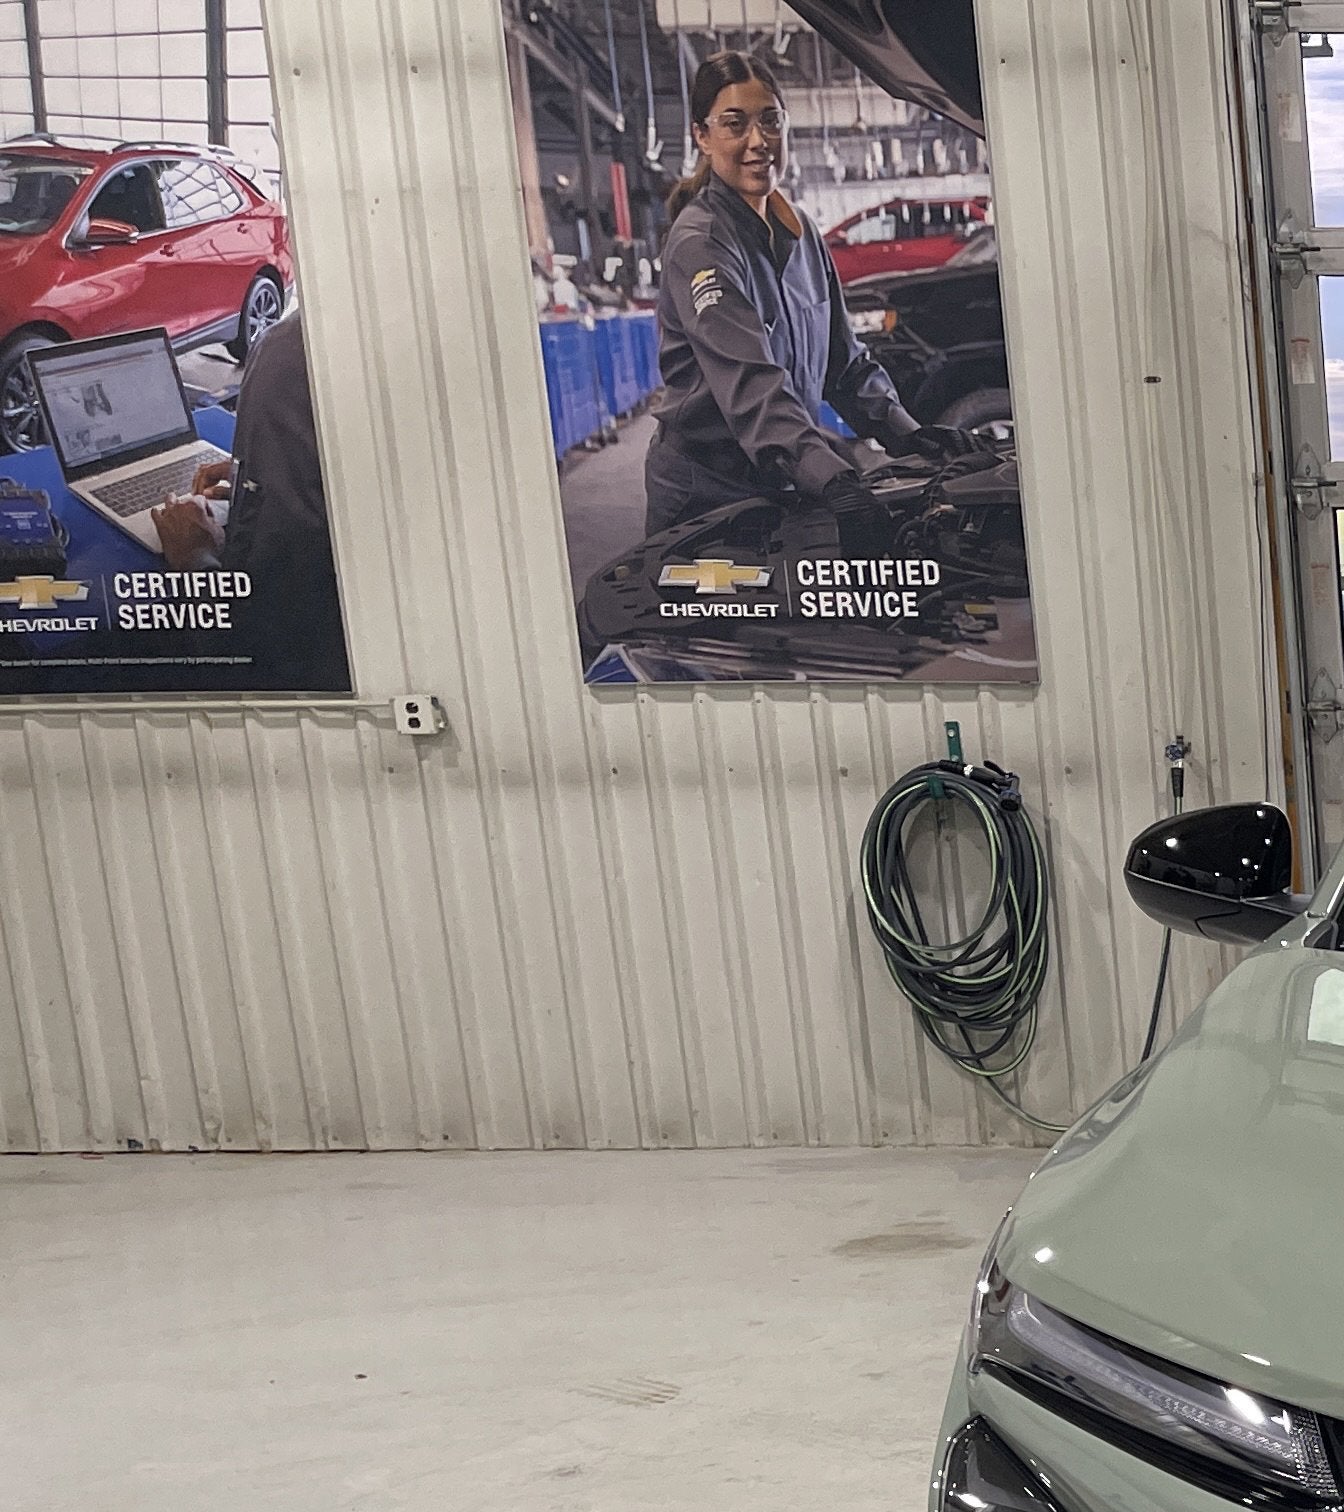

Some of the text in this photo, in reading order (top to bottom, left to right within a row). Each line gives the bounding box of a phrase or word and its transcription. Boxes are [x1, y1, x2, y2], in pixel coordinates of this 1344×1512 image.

[797, 560, 940, 585] CERTIFIED
[114, 572, 252, 599] CERTIFIED
[119, 603, 232, 629] SERVICE
[660, 603, 778, 617] CHEVROLET
[800, 592, 919, 617] SERVICE
[0, 617, 98, 632] HEVROLET
